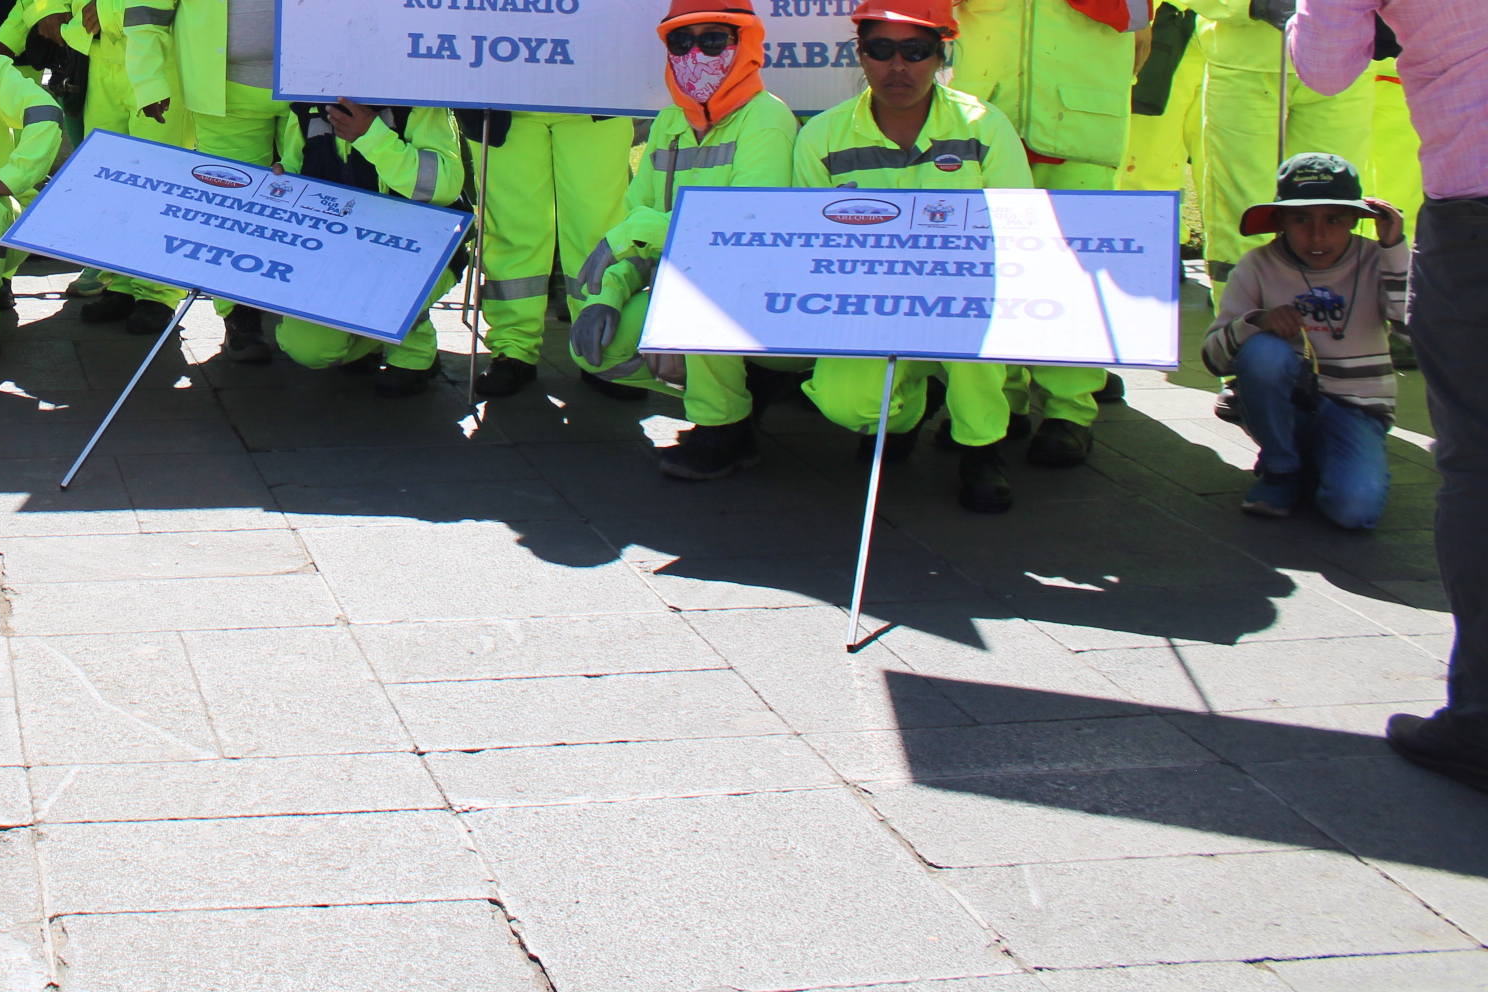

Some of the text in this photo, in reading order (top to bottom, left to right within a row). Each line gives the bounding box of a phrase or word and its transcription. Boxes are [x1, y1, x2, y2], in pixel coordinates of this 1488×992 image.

[407, 32, 574, 68] LA JOYA
[197, 174, 238, 187] AREQUIPA
[93, 166, 421, 253] MANTENIMIENTO VIAL
[159, 203, 323, 250] RUTINARIO
[708, 231, 1142, 253] MANTENIMIENTO VIAL
[163, 234, 293, 283] VITOR
[809, 258, 1024, 277] RUTINARIO
[764, 291, 1064, 321] UCHUMAYO
